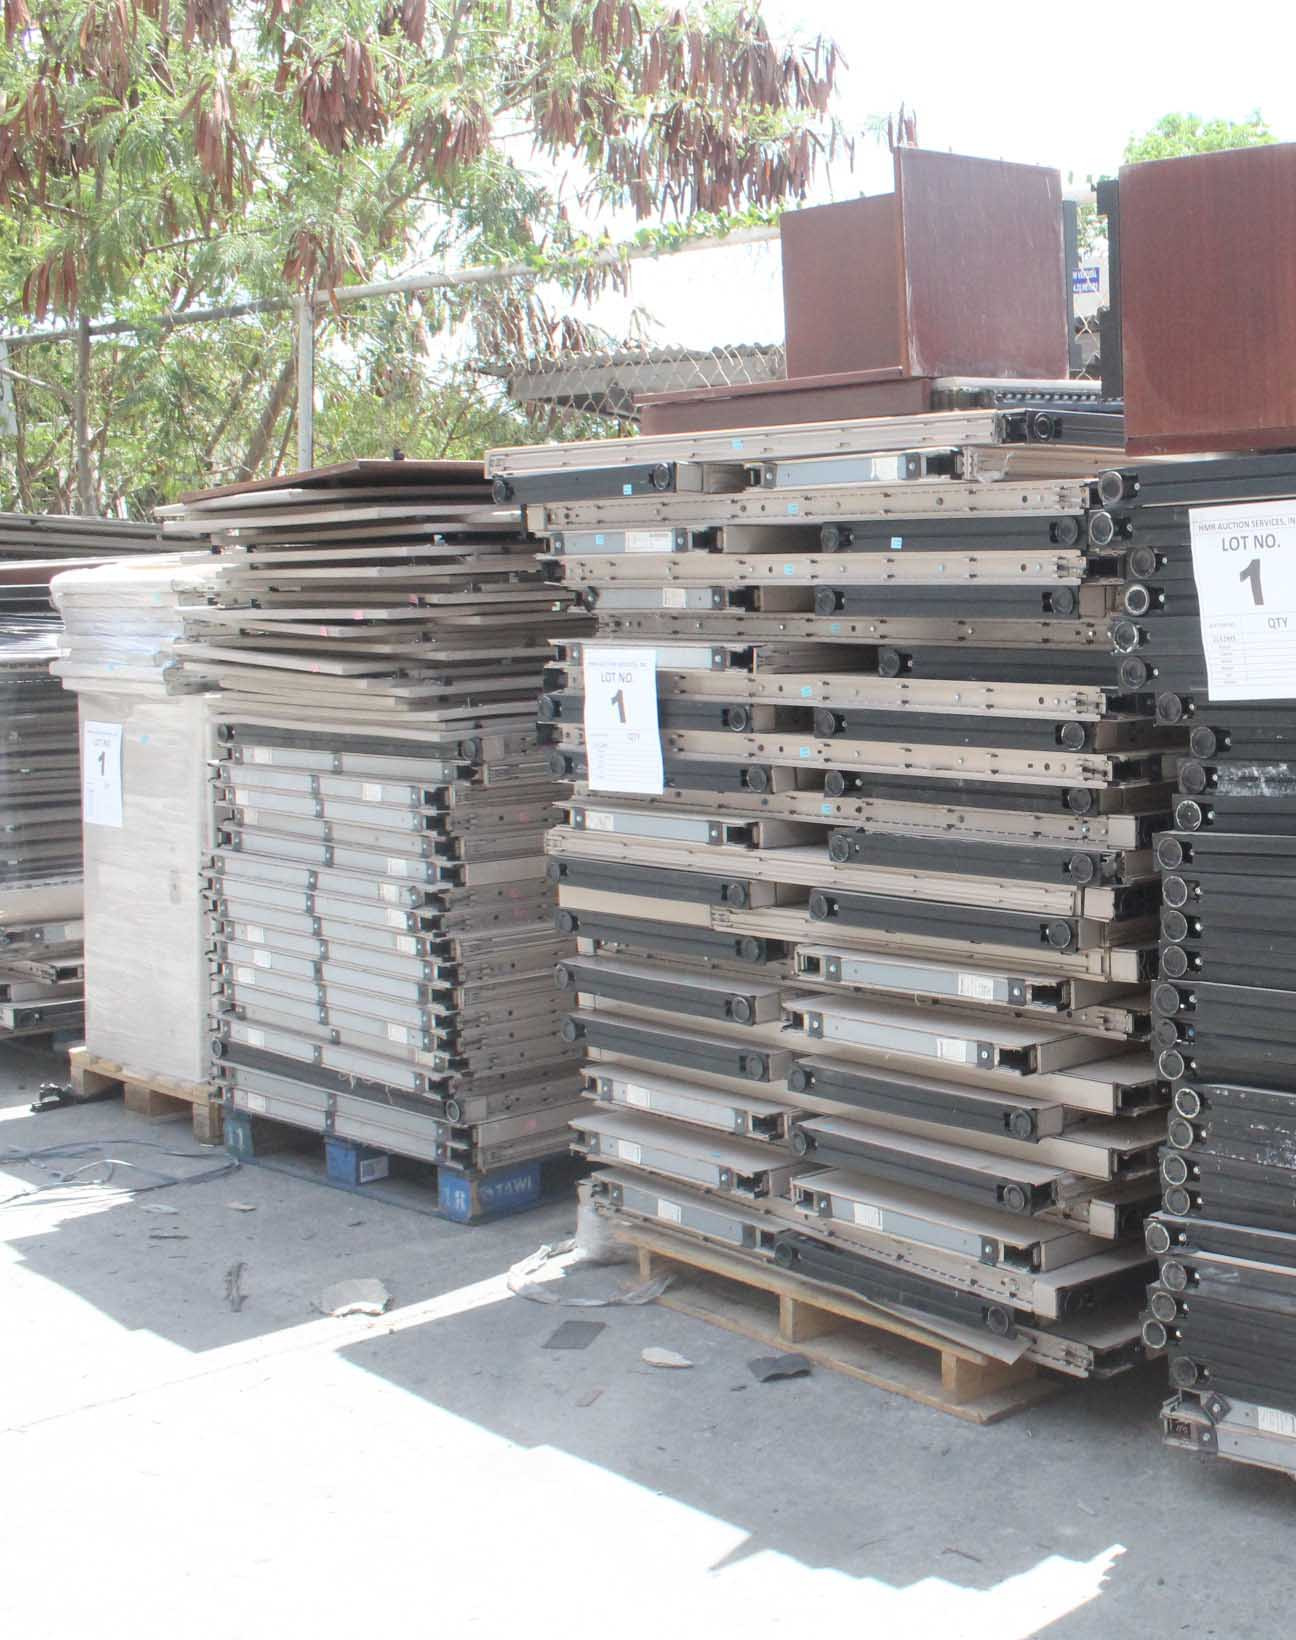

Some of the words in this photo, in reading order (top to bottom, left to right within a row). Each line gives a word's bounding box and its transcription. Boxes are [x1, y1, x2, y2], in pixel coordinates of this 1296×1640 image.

[1217, 520, 1250, 530] AUCTION
[1222, 535, 1249, 552] LOT
[1254, 533, 1281, 549] NO.
[1239, 558, 1264, 605] 1
[1267, 616, 1288, 629] QTY
[601, 671, 616, 683] LOT
[611, 689, 626, 724] 1
[97, 751, 106, 777] 1
